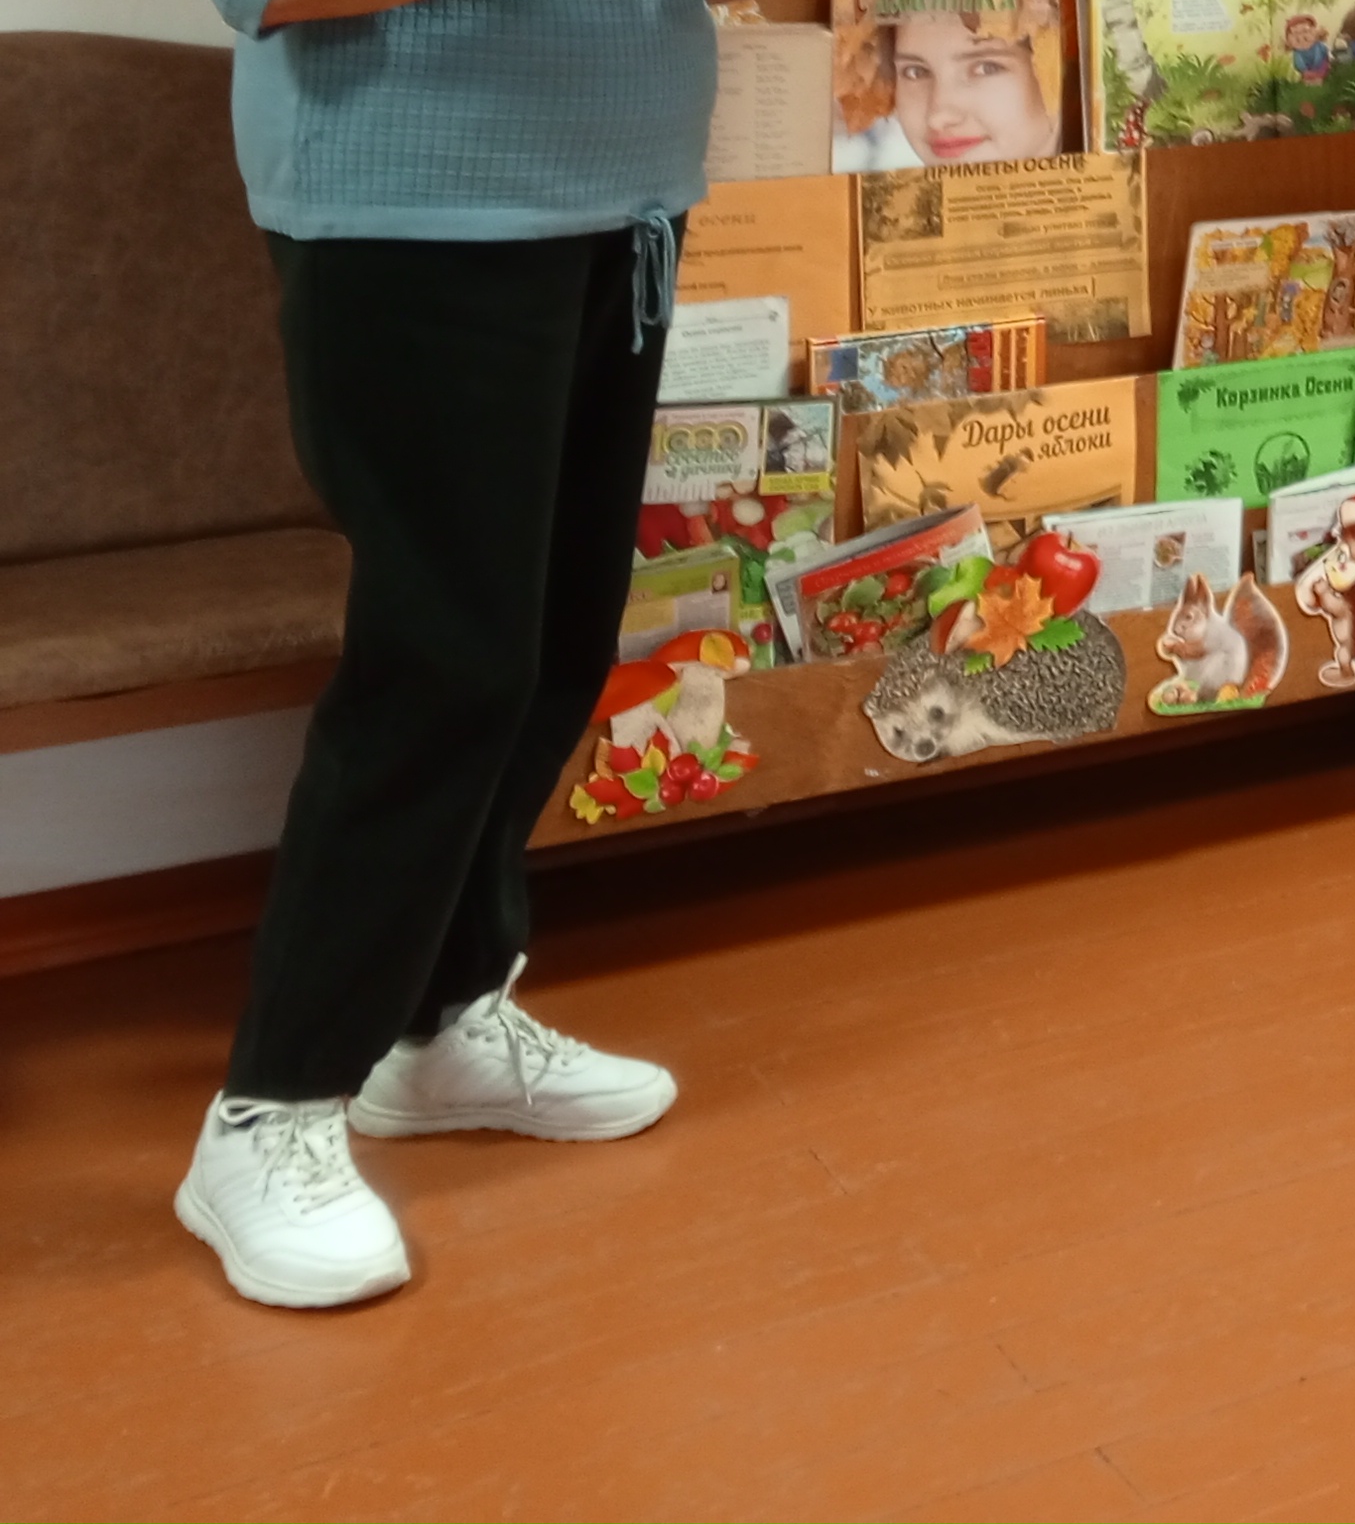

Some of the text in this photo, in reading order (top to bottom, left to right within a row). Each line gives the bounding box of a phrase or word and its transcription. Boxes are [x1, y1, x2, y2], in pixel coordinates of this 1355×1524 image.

[924, 160, 1018, 182] ПРИМЕТЫ
[1217, 376, 1354, 409] Корзинка Осени
[962, 403, 1112, 451] Дары осени
[1036, 431, 1112, 461] яблоки
